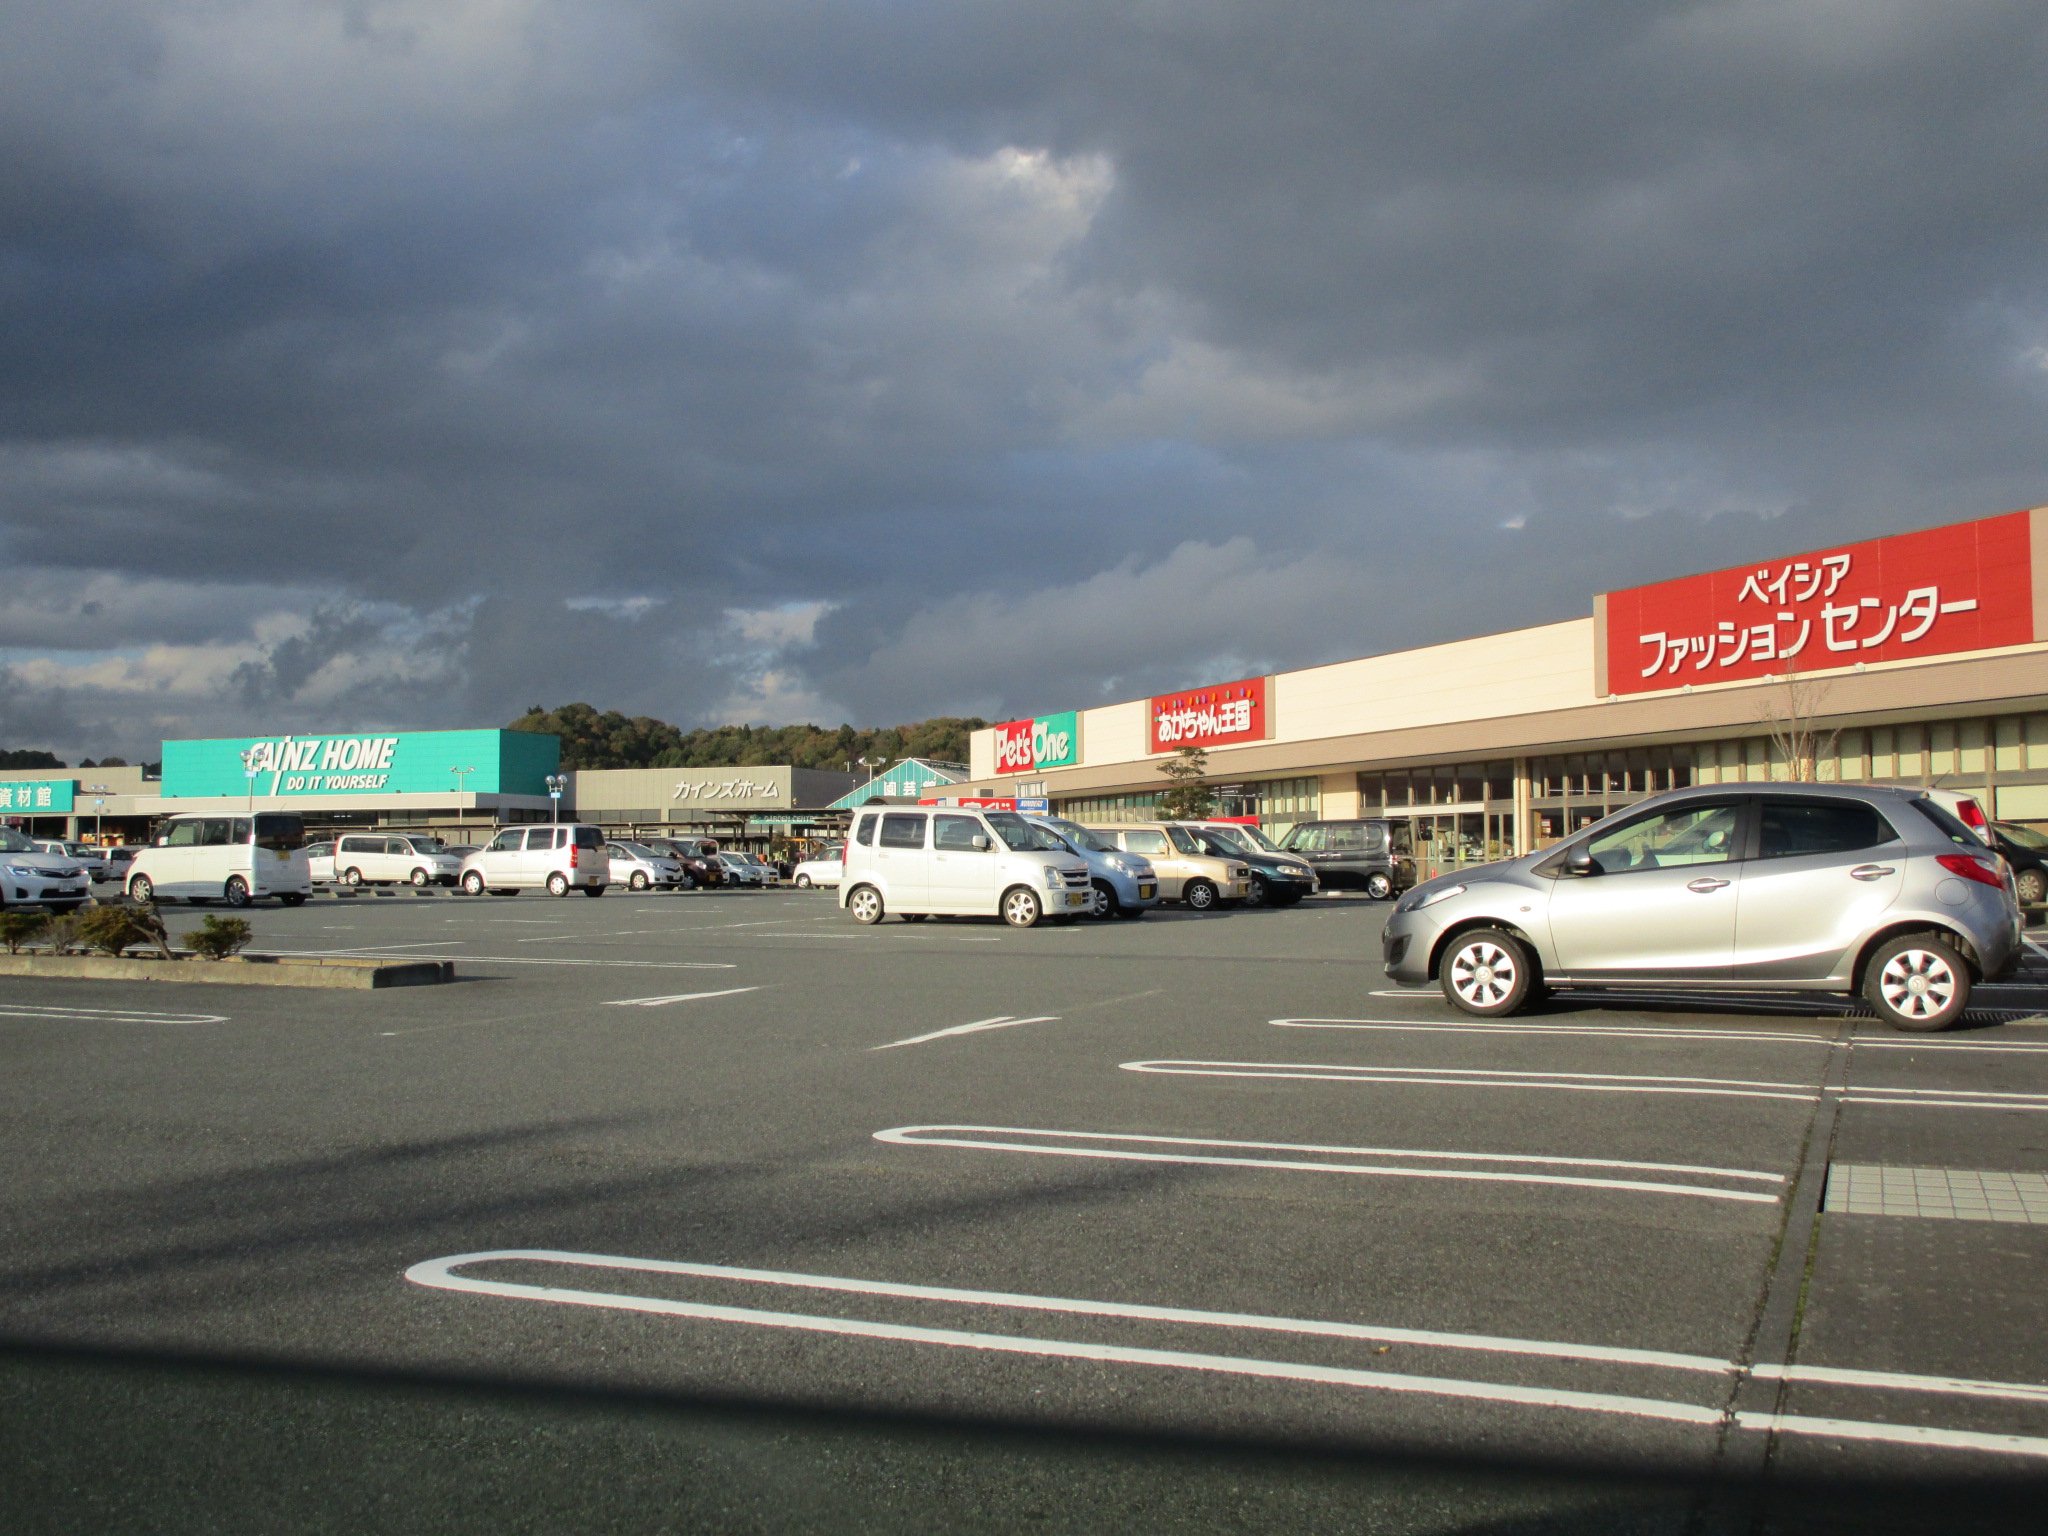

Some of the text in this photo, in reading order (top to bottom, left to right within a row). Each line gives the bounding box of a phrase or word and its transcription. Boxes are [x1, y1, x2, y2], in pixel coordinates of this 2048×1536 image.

[1738, 554, 1851, 605] ベイシア
[1158, 699, 1251, 742] あかちゃん王国
[321, 738, 399, 770] HOME
[286, 775, 388, 790] DO IT YOURSELF
[672, 778, 779, 799] カインズホーム
